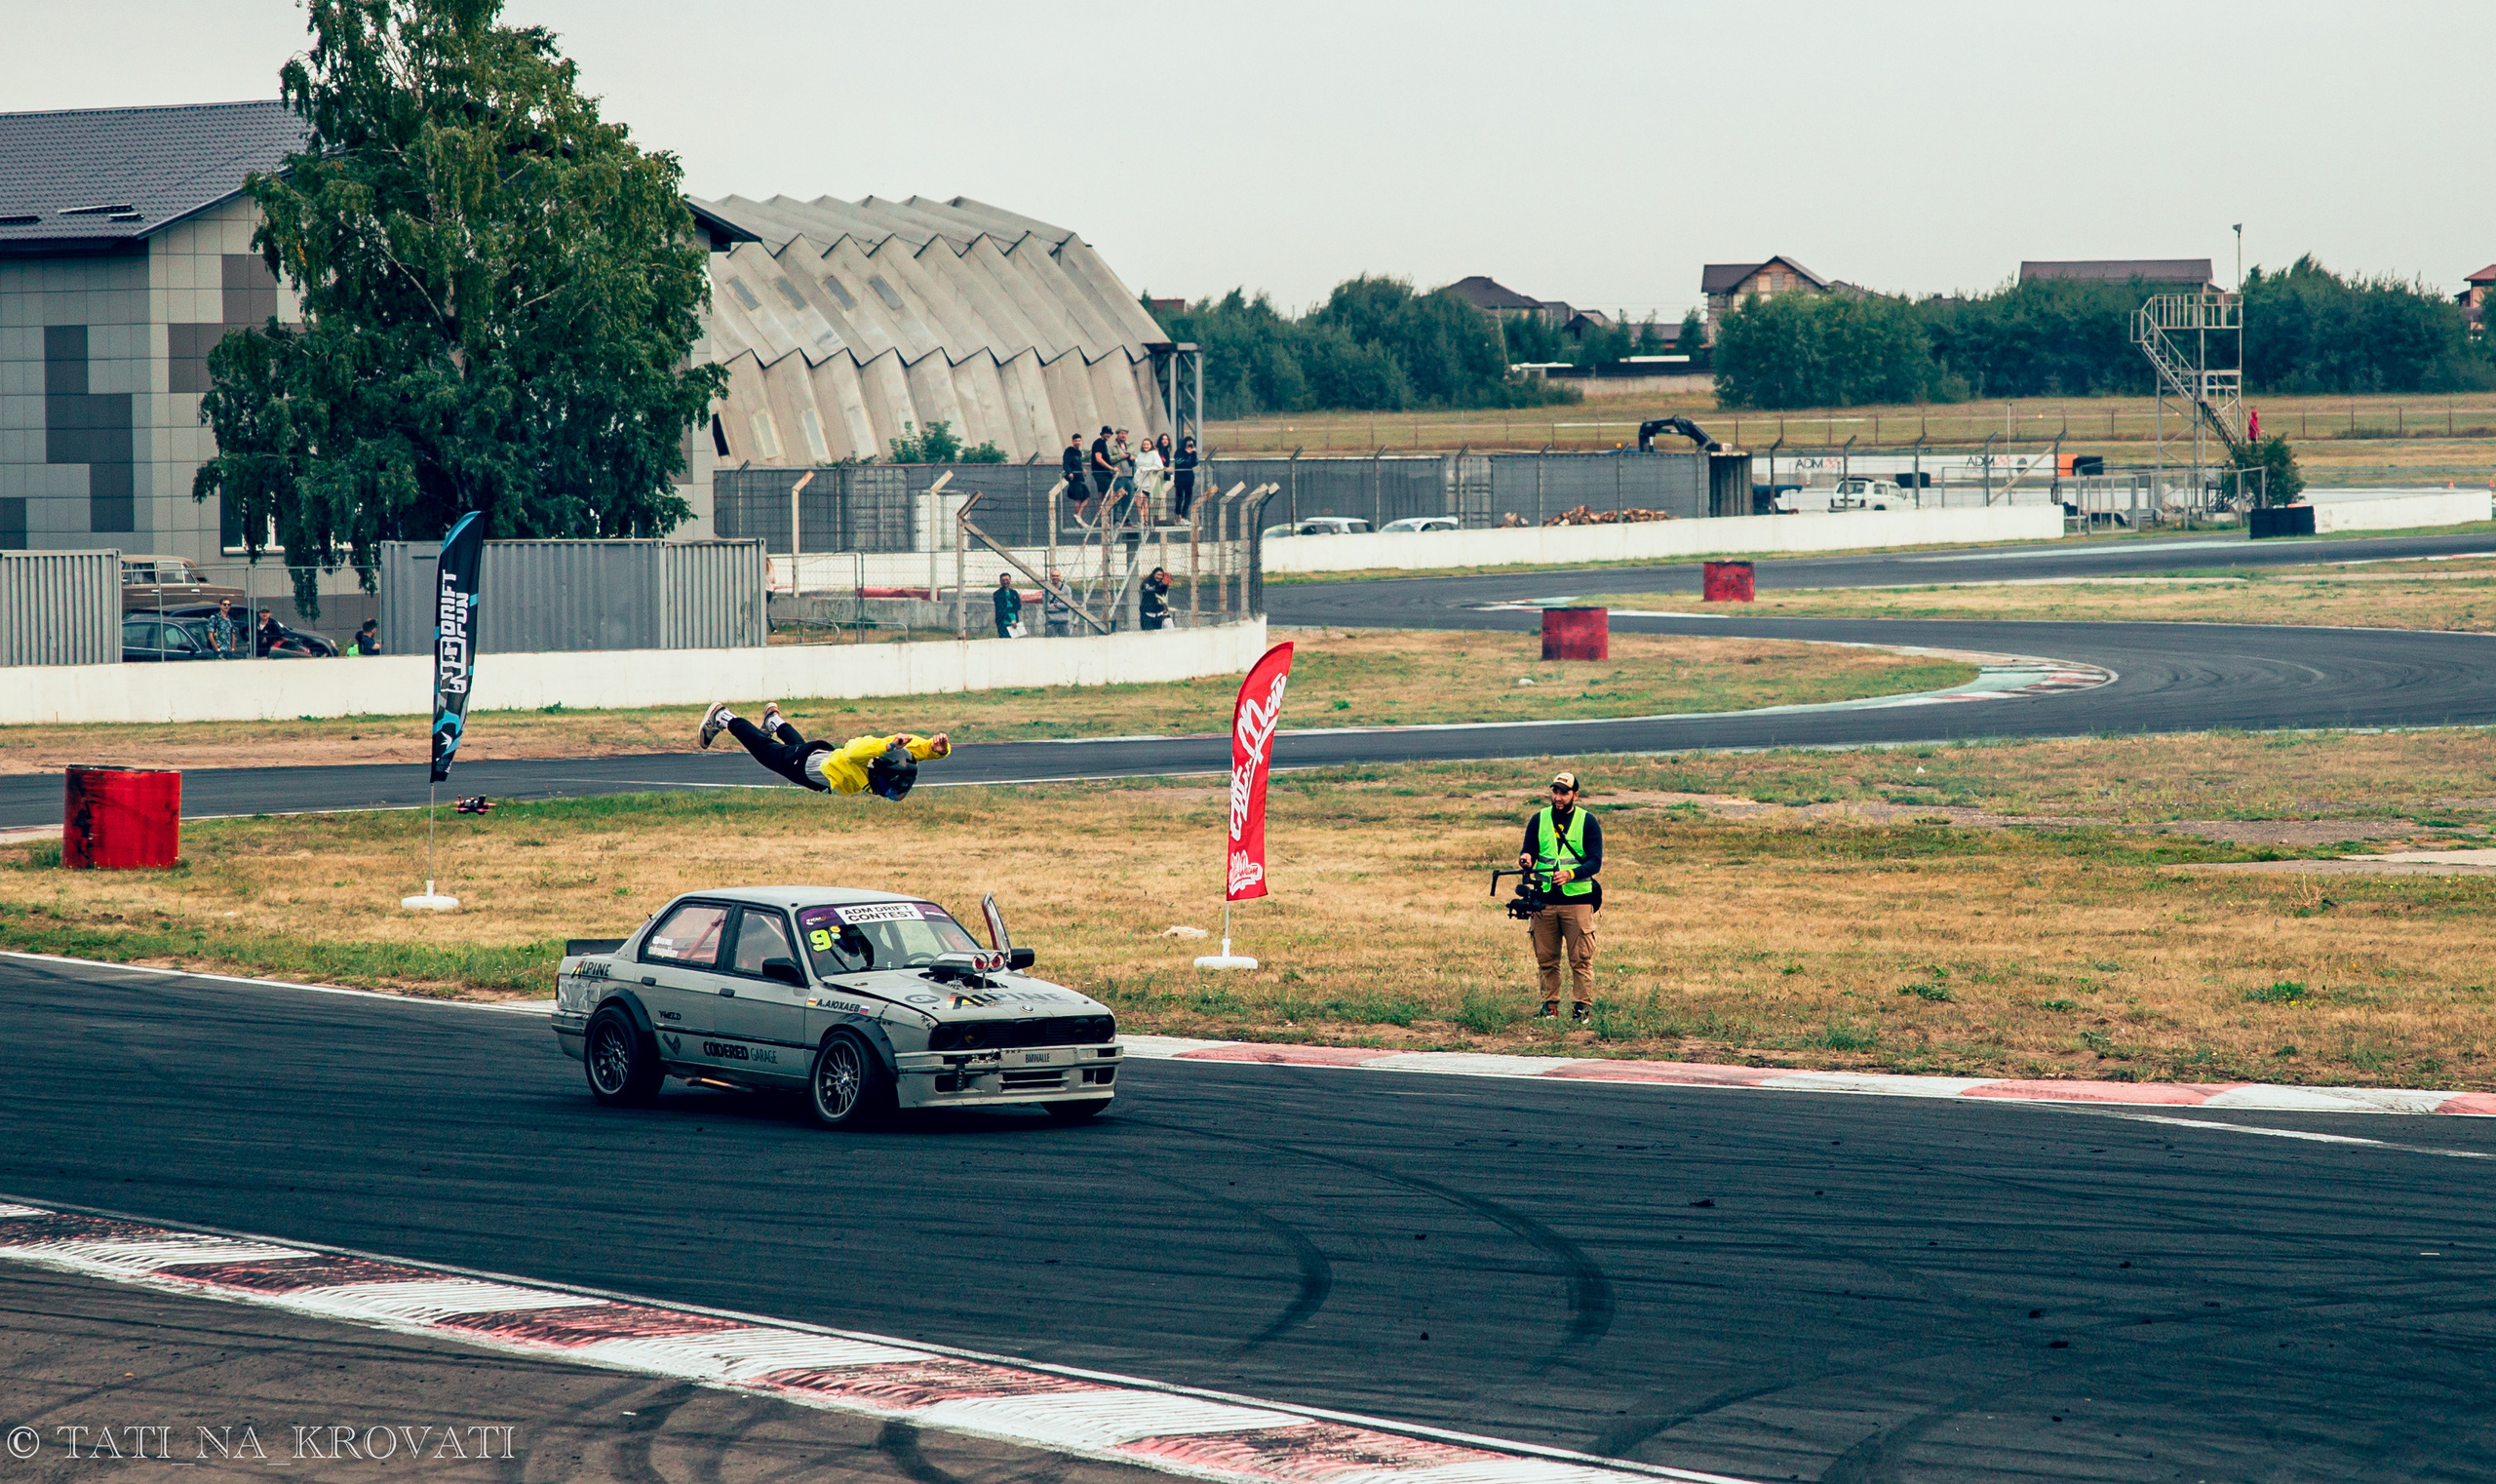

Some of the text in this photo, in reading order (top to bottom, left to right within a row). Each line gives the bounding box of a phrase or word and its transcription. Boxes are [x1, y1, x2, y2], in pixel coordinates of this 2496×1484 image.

[1796, 458, 1823, 468] ADM
[1967, 456, 1995, 466] ADM
[441, 569, 456, 635] DRIFT
[456, 592, 469, 637] FUN
[844, 907, 873, 916] ADM
[847, 911, 916, 922] CONTEST
[570, 959, 612, 979] ALPINE
[946, 992, 1069, 1010] ALPINE
[703, 1041, 778, 1064] CODERED GARAGE
[1025, 1053, 1050, 1064] BMWALLE
